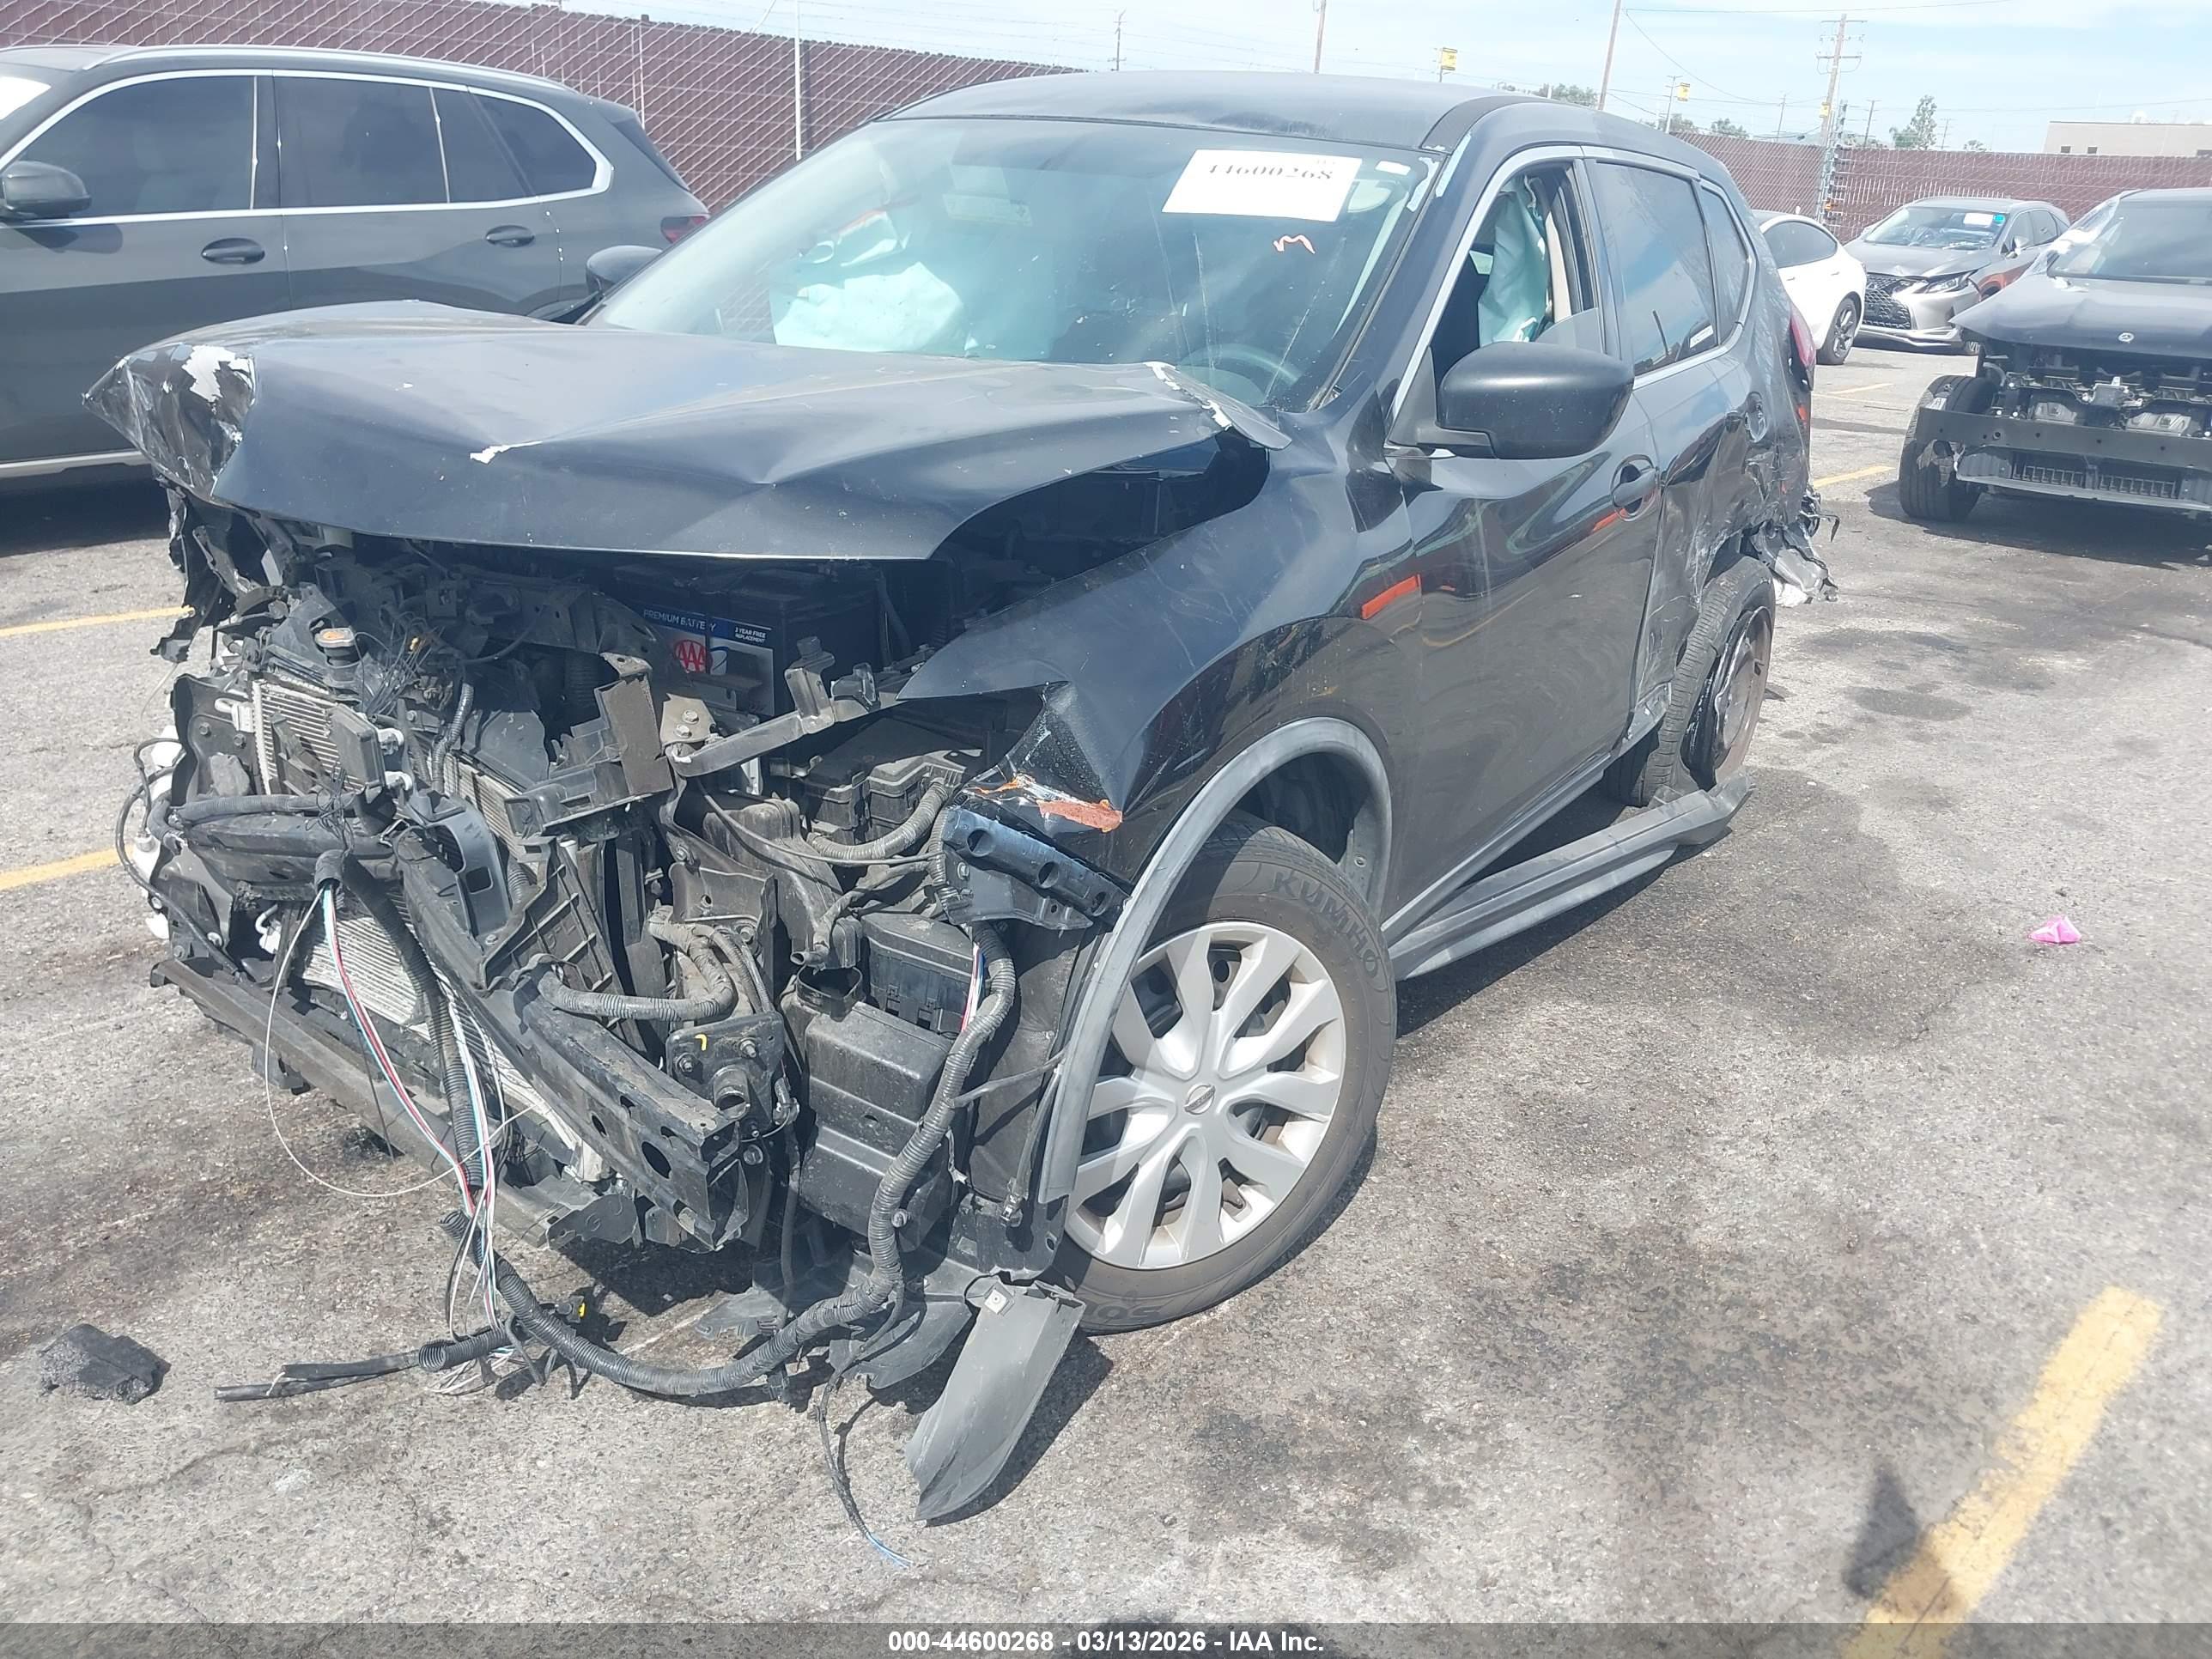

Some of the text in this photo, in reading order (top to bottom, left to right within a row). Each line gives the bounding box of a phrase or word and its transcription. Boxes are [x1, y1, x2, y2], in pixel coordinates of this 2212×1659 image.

[643, 609, 716, 633] PREMIUM BATTEY
[1273, 871, 1378, 978] KUMHO
